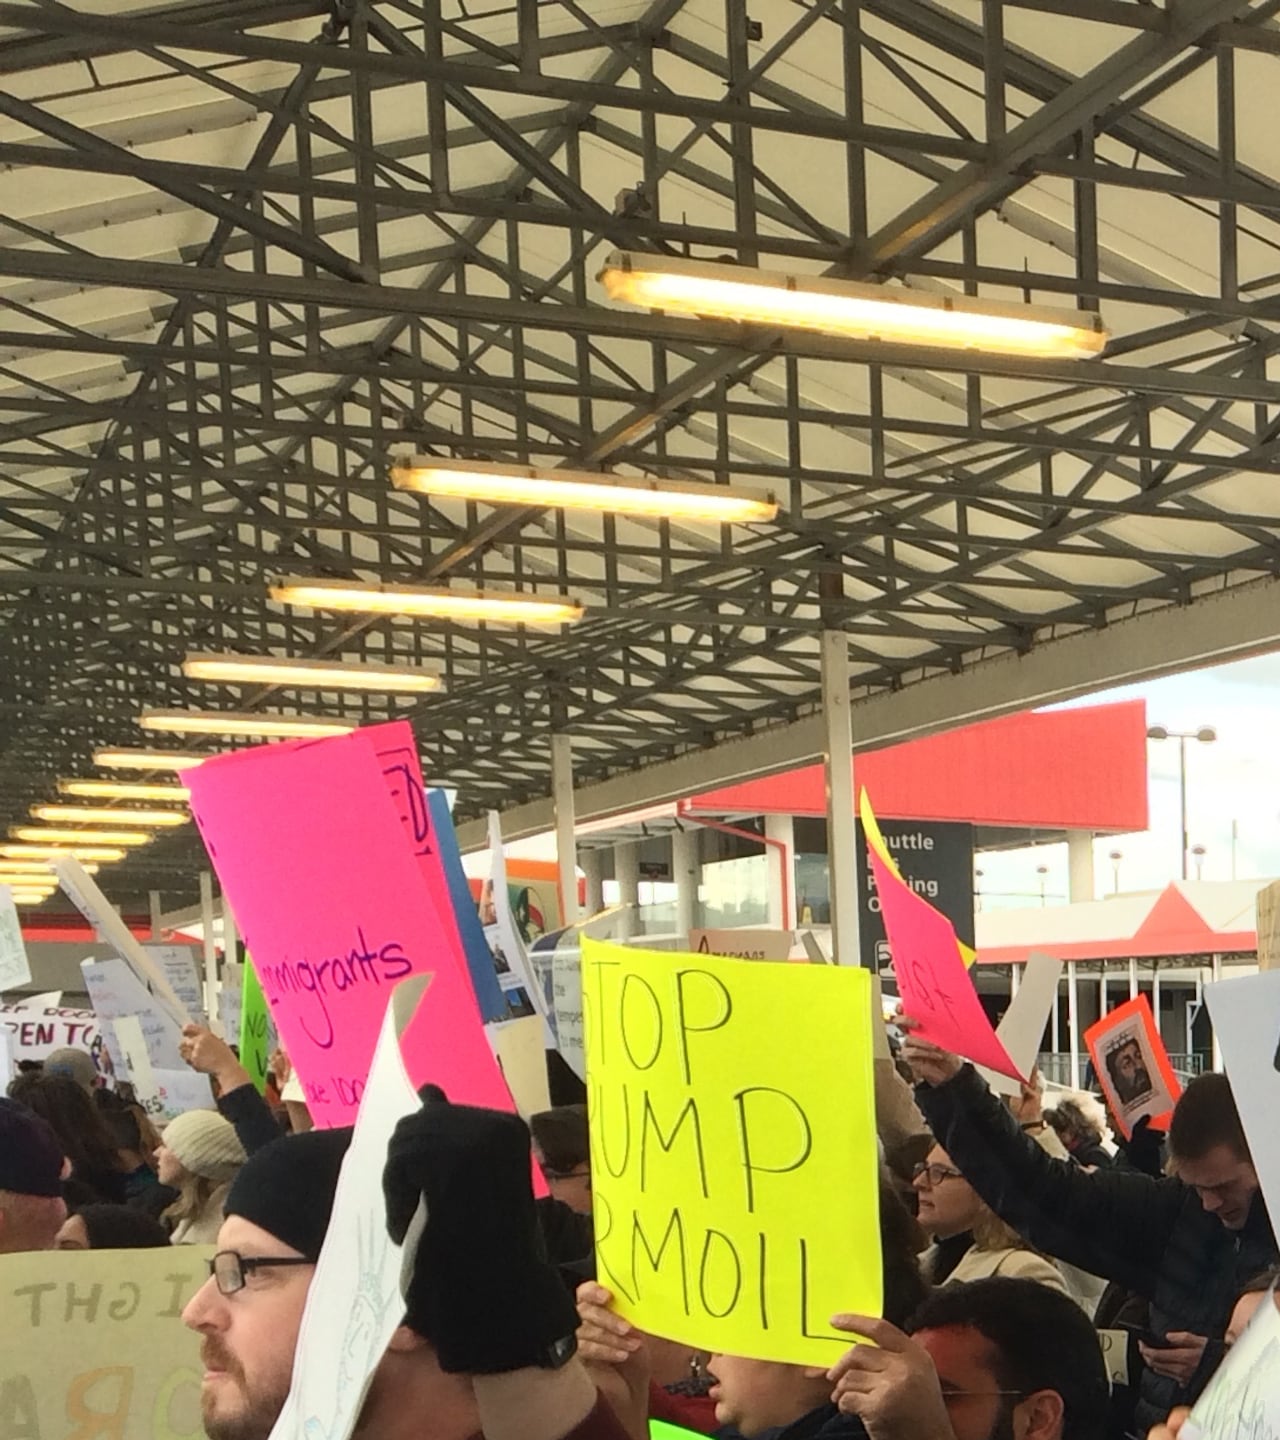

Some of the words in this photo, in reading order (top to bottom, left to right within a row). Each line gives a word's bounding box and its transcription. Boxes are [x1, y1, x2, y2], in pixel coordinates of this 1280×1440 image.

[880, 833, 935, 850] uttle
[867, 875, 938, 897] Ping
[262, 925, 413, 1049] mmigrants
[583, 961, 733, 1087] TOP
